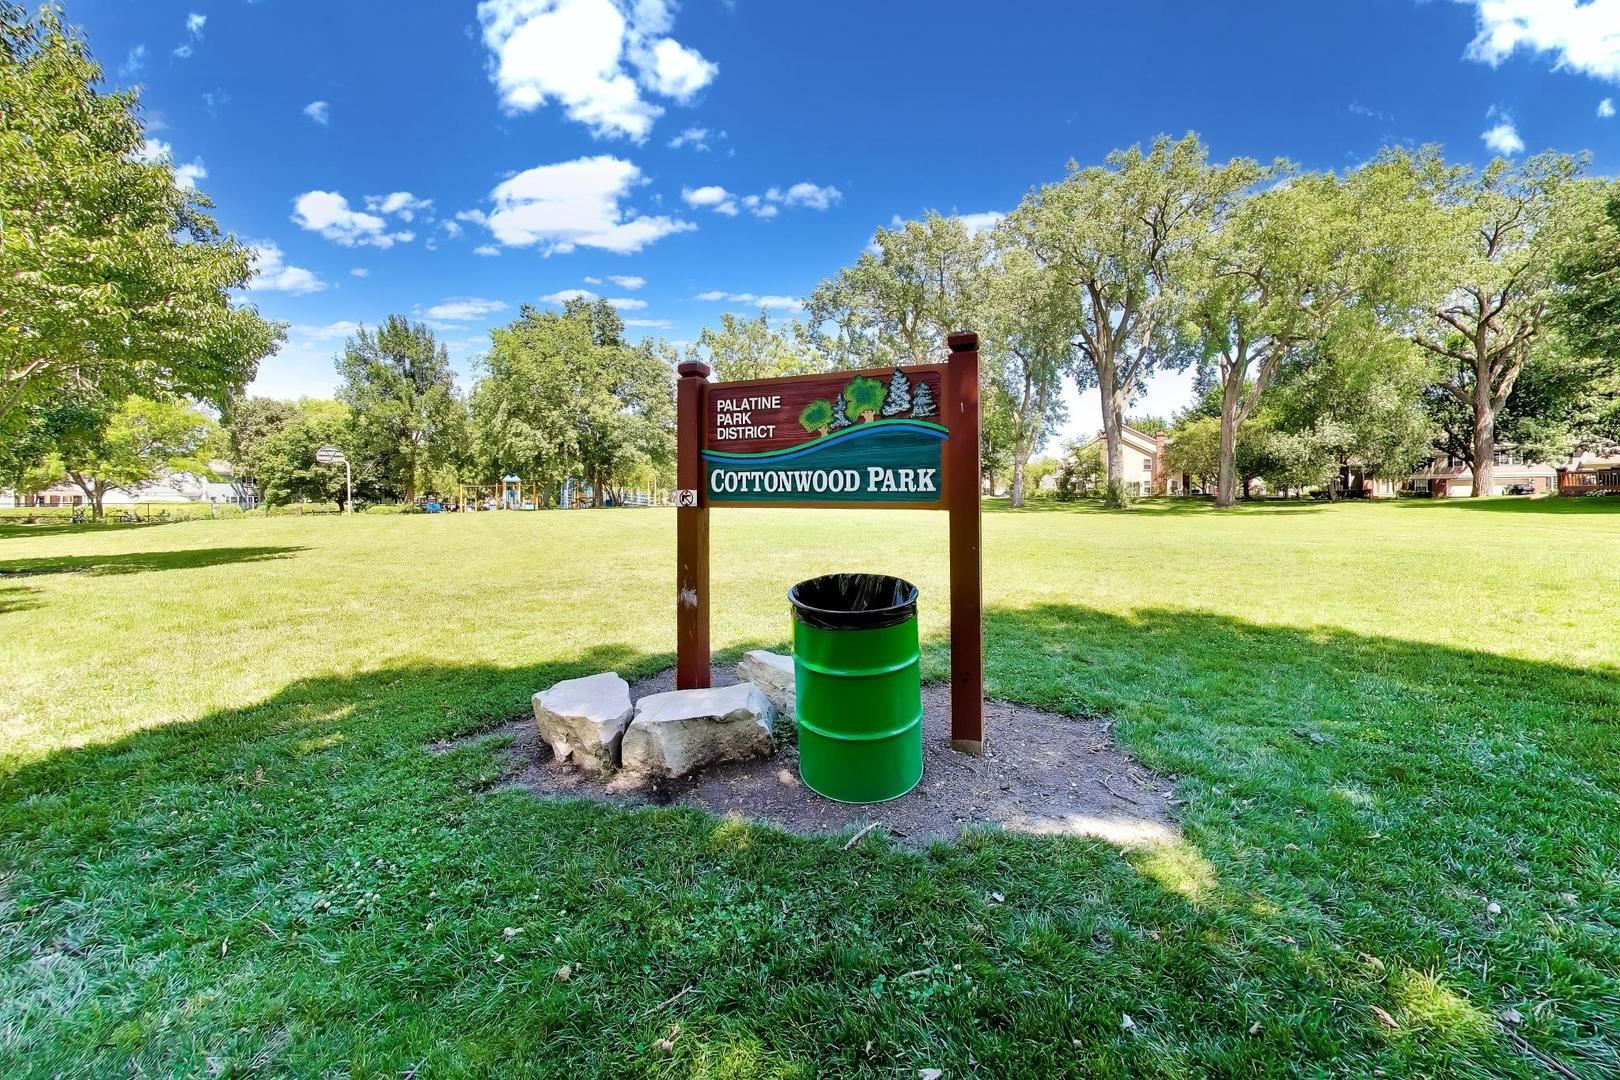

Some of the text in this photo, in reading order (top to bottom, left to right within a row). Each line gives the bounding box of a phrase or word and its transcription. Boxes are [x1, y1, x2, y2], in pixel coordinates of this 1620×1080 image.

[717, 396, 781, 412] PALATINE
[717, 412, 751, 425] PARK
[717, 425, 775, 440] DISTRICT
[711, 467, 936, 493] COTTONWOOD PARK
